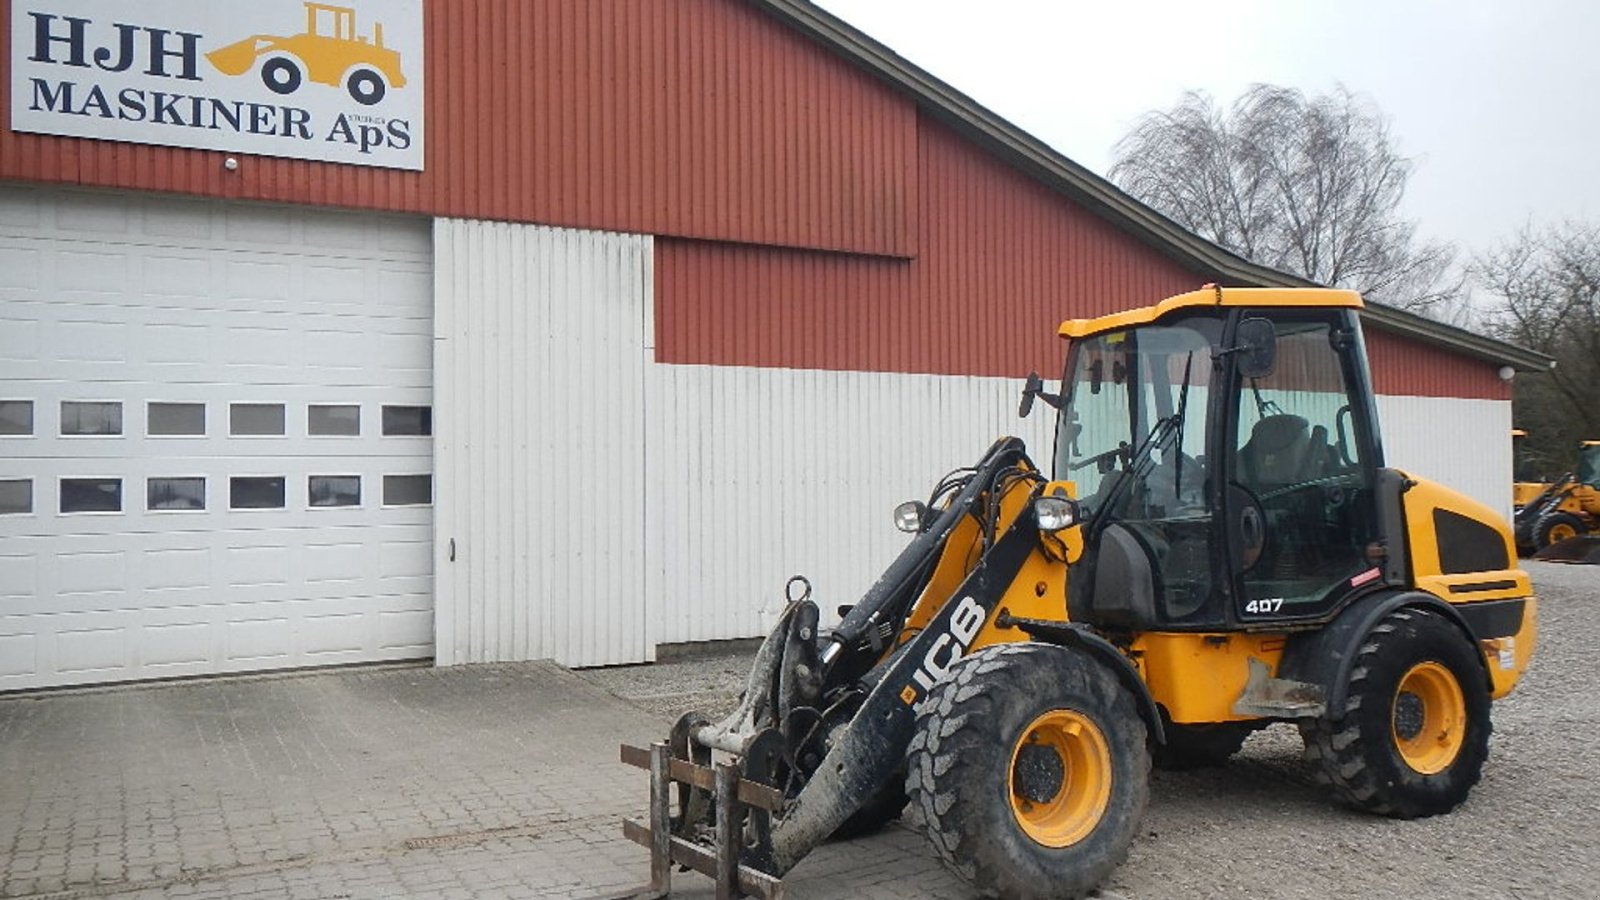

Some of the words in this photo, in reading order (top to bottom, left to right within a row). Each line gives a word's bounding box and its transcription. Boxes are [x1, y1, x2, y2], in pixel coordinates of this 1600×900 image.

[27, 11, 203, 81] HJH
[29, 77, 313, 140] MASKINER
[325, 112, 411, 154] ApS
[1245, 598, 1284, 613] 407
